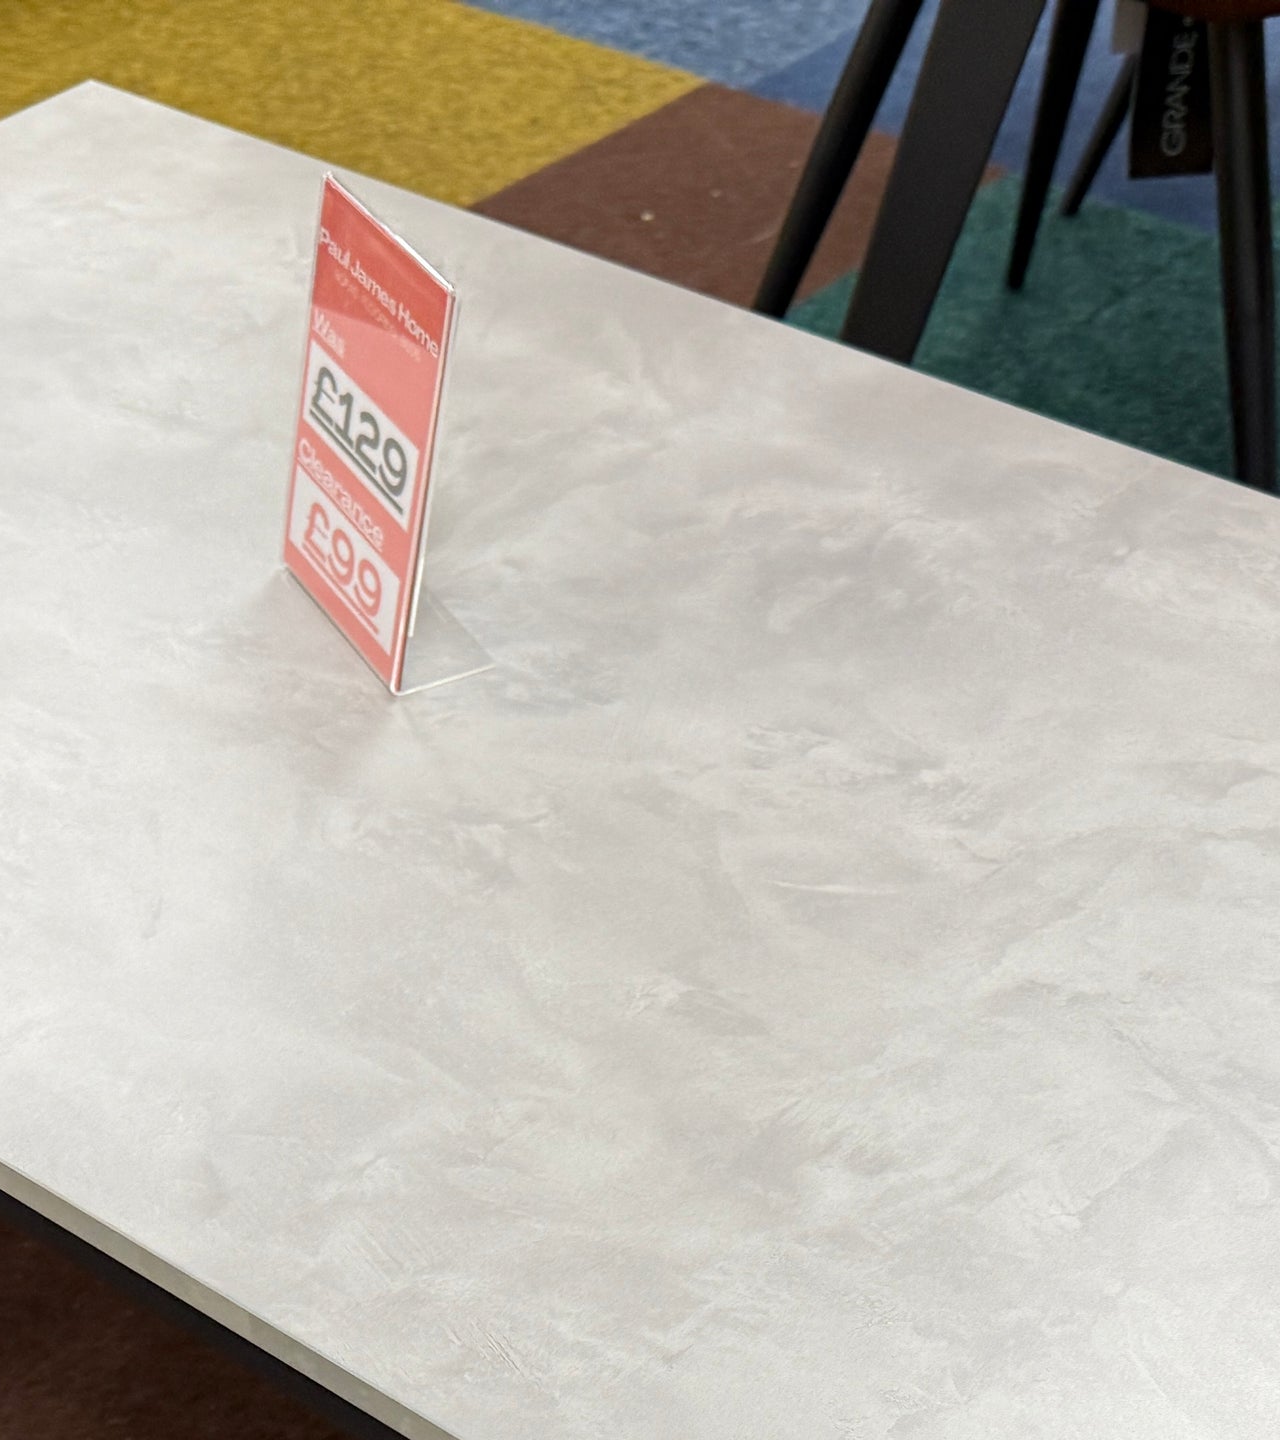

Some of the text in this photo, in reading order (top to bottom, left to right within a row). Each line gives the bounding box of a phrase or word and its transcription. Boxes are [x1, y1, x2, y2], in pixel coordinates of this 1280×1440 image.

[1160, 31, 1199, 156] GRANDE
[312, 306, 345, 359] Was
[320, 226, 350, 268] Paul
[350, 260, 396, 316] James
[397, 302, 439, 358] Home
[311, 366, 408, 497] £129
[298, 438, 384, 549] Clearance
[304, 502, 382, 618] £99
